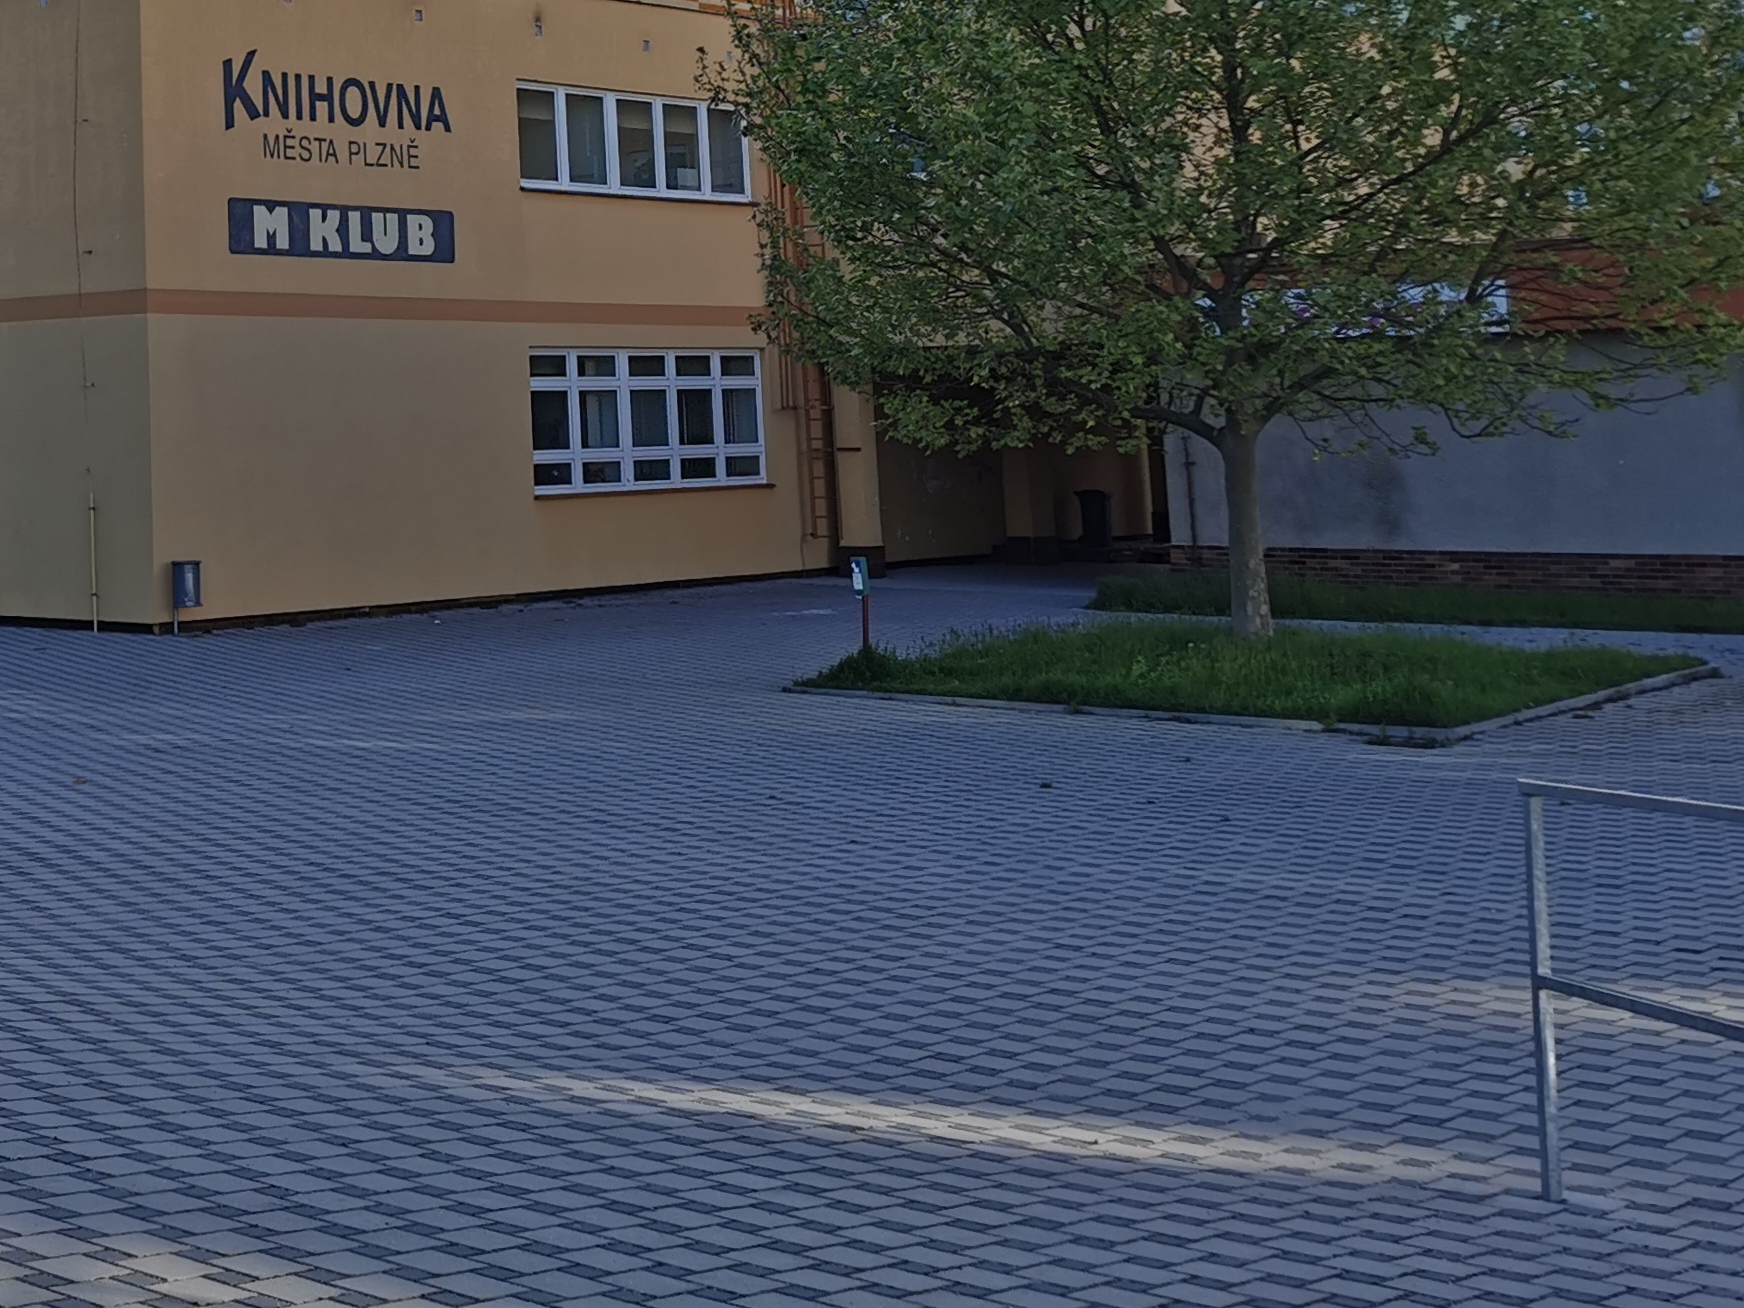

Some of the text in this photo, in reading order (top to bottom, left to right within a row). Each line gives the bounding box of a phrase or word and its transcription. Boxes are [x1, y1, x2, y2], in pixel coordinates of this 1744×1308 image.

[222, 49, 452, 133] KNIHOVNA
[263, 127, 420, 169] MĚSTA PLZNĚ
[253, 204, 436, 256] M KLUB
